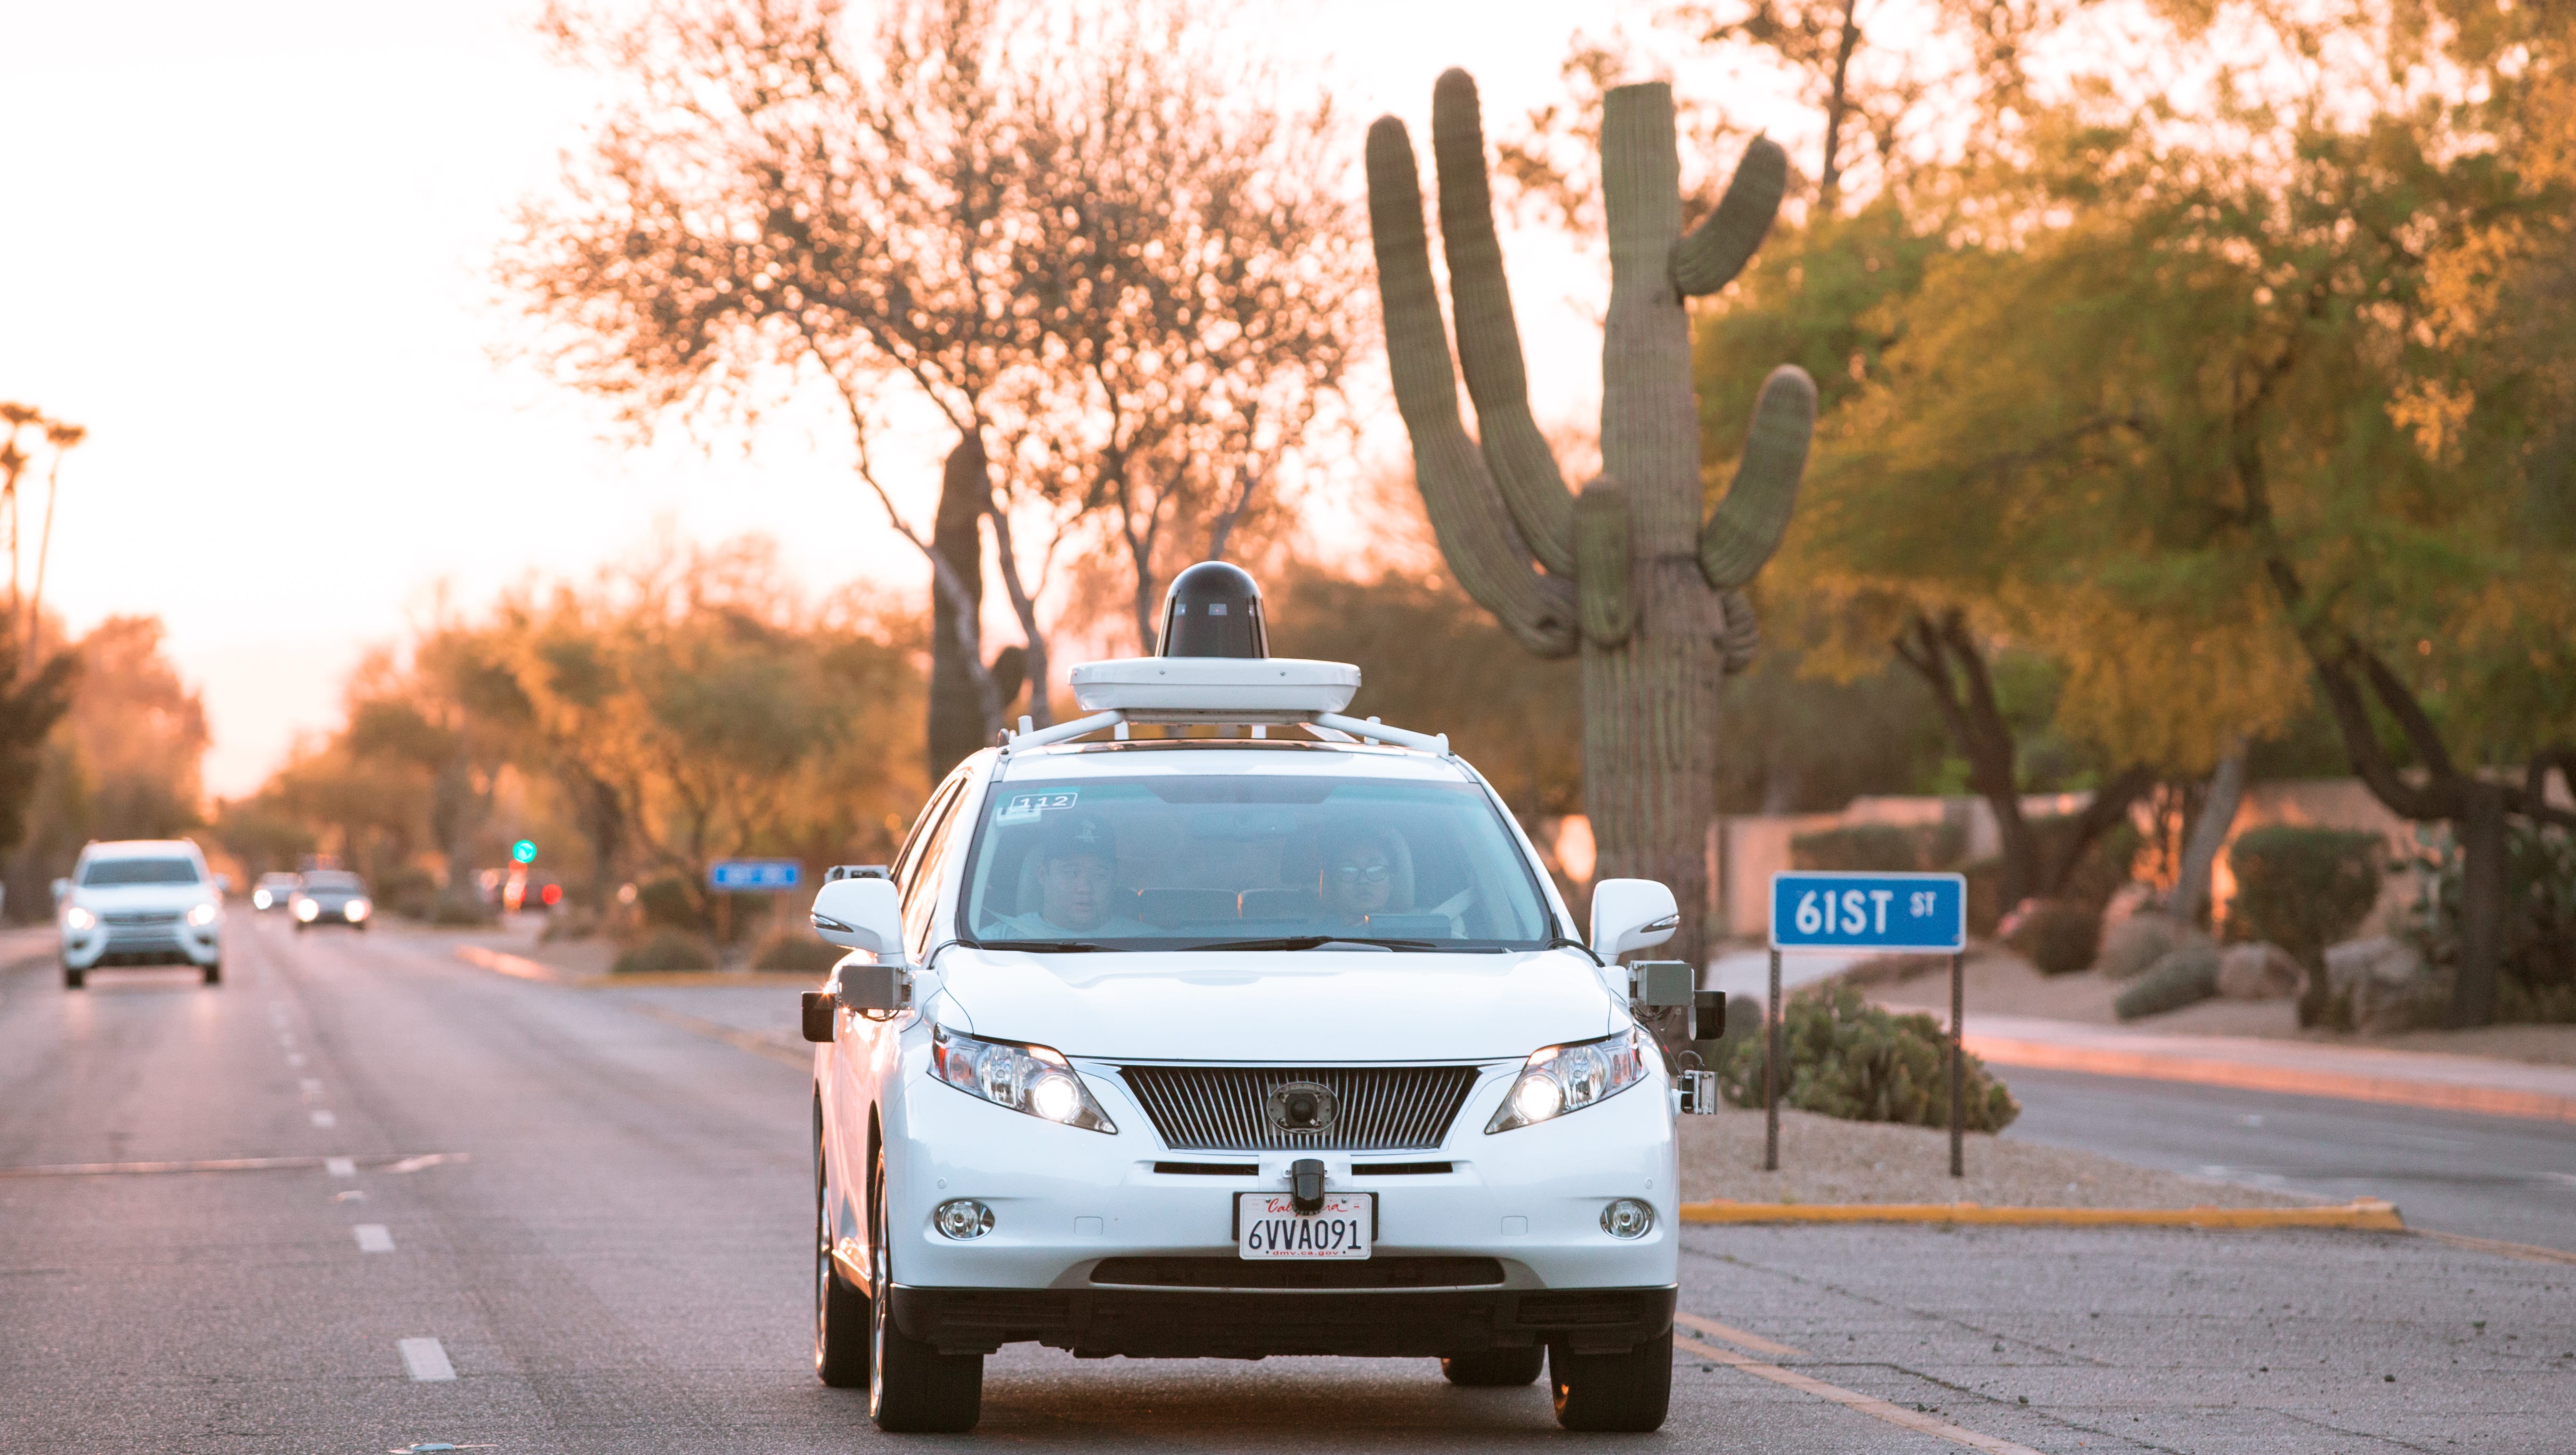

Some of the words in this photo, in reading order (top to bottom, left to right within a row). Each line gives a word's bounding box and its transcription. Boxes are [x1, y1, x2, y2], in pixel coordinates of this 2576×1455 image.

[1020, 796, 1068, 808] 112
[1796, 889, 1893, 935] 61ST
[1910, 892, 1936, 918] ST
[1268, 1198, 1348, 1216] Calia
[1249, 1220, 1361, 1249] 6VVA091
